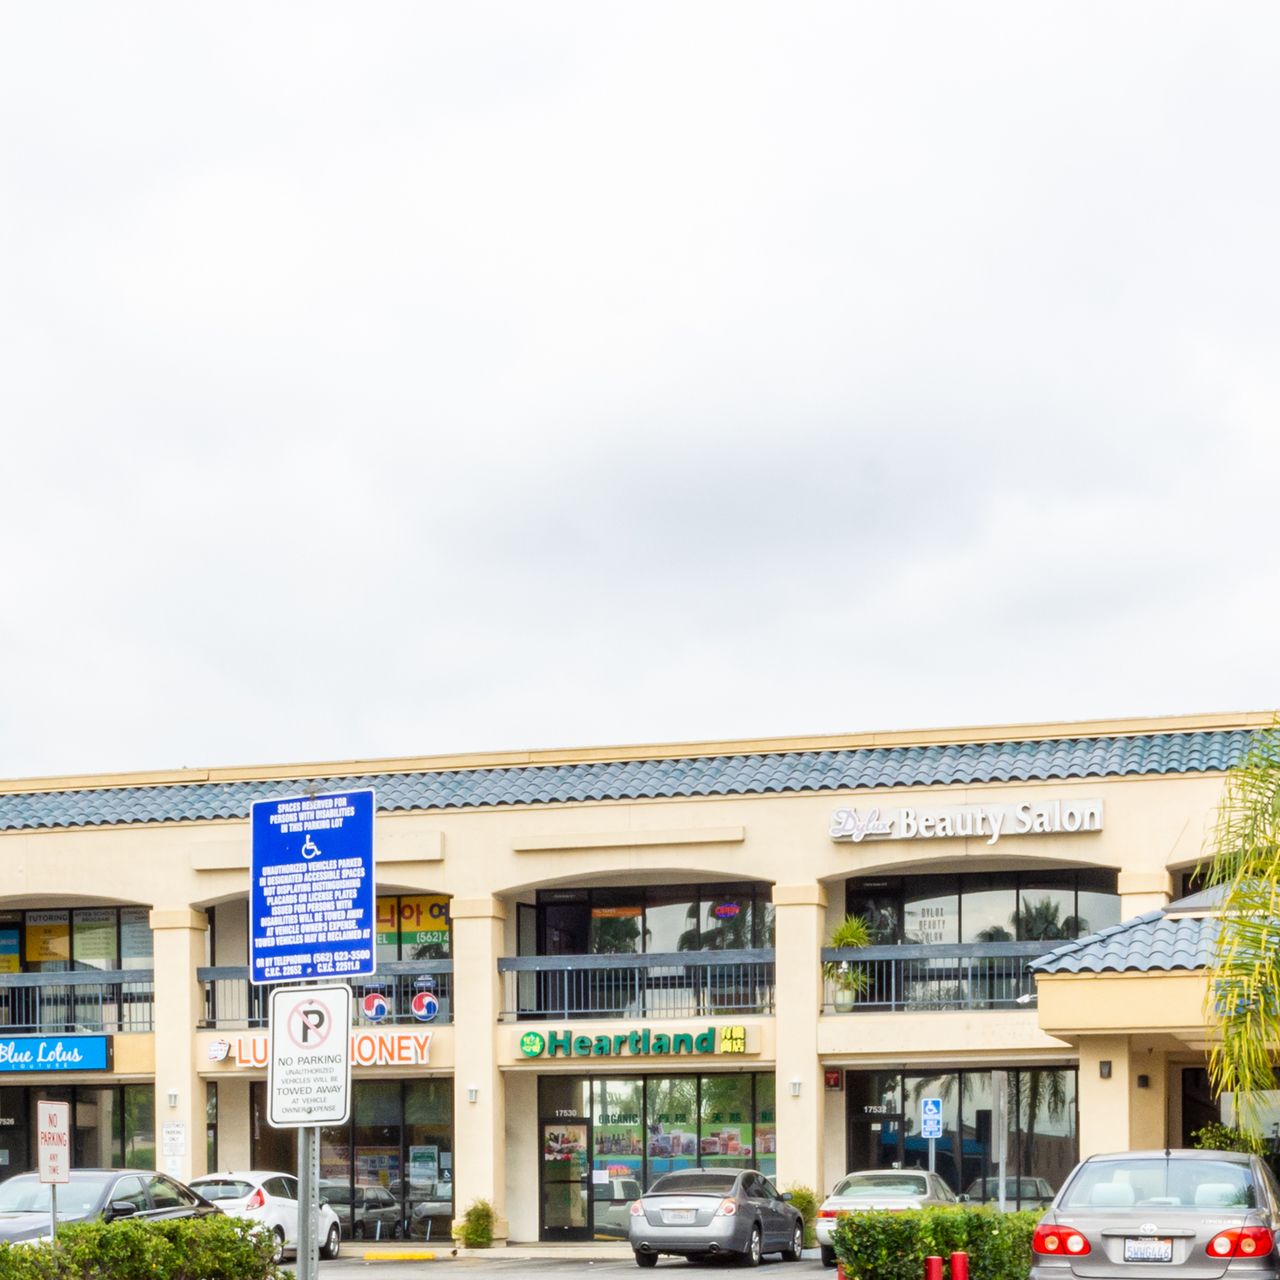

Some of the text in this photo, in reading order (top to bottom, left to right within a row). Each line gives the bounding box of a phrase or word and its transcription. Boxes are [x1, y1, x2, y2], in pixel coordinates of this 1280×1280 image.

[278, 797, 347, 813] SPACES RESERVED FOR
[270, 807, 355, 824] PERSONS WITH DISABILITIES
[900, 807, 1004, 845] Beauty
[1015, 800, 1102, 833] Salon
[289, 822, 303, 832] THIS
[304, 819, 330, 831] PARKING
[331, 818, 344, 828] LOT
[262, 857, 362, 876] UNAUTHORIZED VEHICLES PARKED
[267, 873, 303, 885] DESIGNATED
[304, 869, 340, 882] ACCESSIBLE
[341, 867, 365, 878] SPACES
[267, 889, 357, 906] PLACARDS OR LICENSE PLATES
[272, 899, 352, 916] ISSUED FOR PERSONS WITH
[921, 908, 944, 918] DYLUX
[29, 914, 68, 922] TUTORING
[299, 913, 313, 923] WILL
[314, 912, 323, 922] BE
[324, 910, 345, 921] TOWED
[346, 909, 364, 919] AWAY
[376, 904, 423, 927] 니아
[266, 927, 274, 936] AT
[275, 925, 299, 935] VEHICLE
[919, 920, 945, 930] BEAUTY
[255, 929, 371, 948] TOWED VEHICLES MAY BE RECLAIMED AT
[416, 932, 442, 943] (562)
[256, 950, 370, 968] OR BY TELEPHONING (562) 623-3500
[548, 1027, 716, 1057] Heartland
[36, 1042, 83, 1062] Lotus
[278, 1055, 342, 1066] NO PARKING
[285, 1067, 335, 1076] UNAUTHORIZED
[277, 1085, 342, 1095] TOWED AWAY
[48, 1113, 58, 1128] NO
[599, 1114, 638, 1124] ORGANIC
[41, 1131, 67, 1147] PARKING
[48, 1166, 59, 1175] TIME
[1127, 1246, 1169, 1258] 5WWG446
